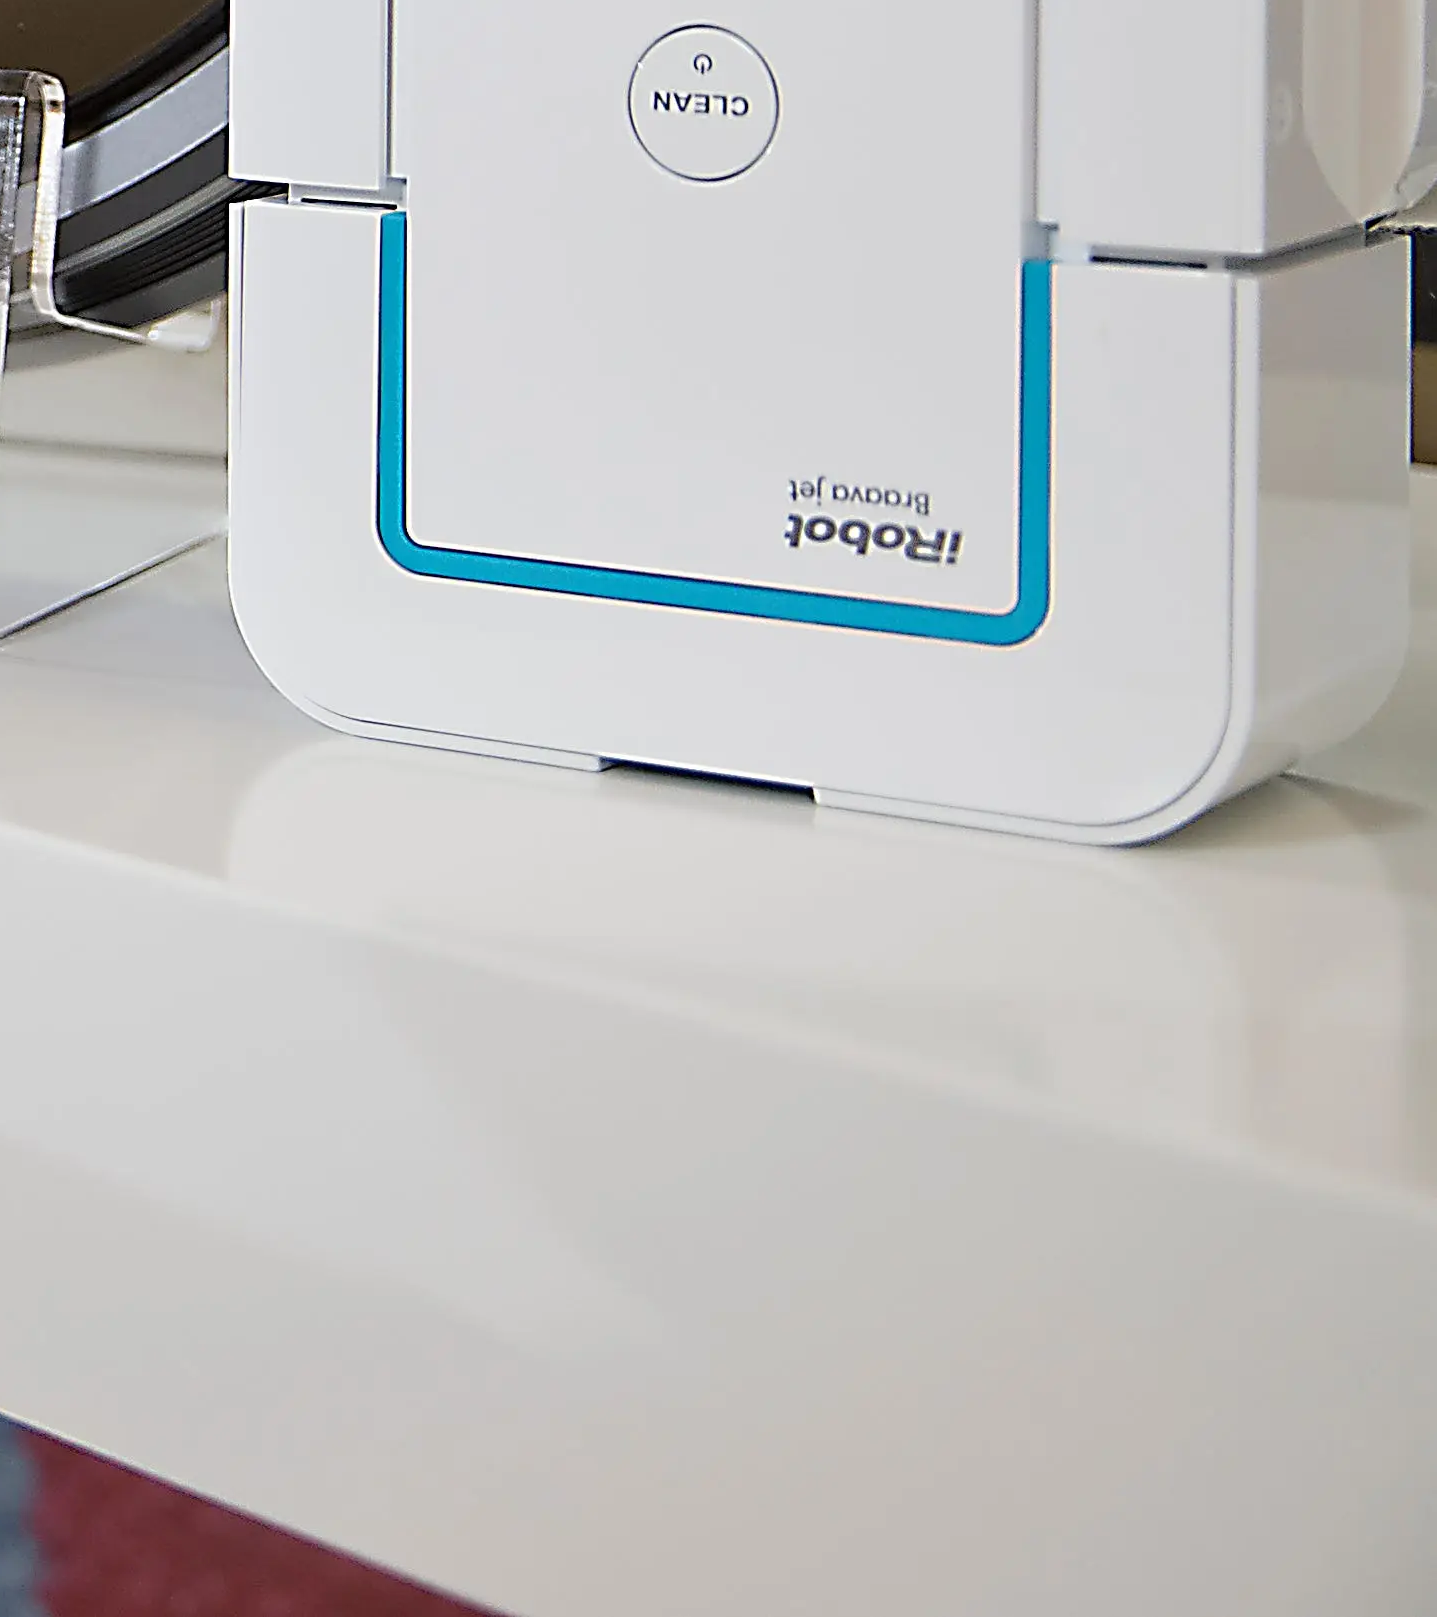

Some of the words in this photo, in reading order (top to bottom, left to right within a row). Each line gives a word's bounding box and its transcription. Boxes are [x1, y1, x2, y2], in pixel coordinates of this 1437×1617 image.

[652, 90, 750, 117] CLEAN
[788, 475, 826, 507] jet
[832, 483, 931, 517] Braava
[784, 513, 965, 565] iRobot
